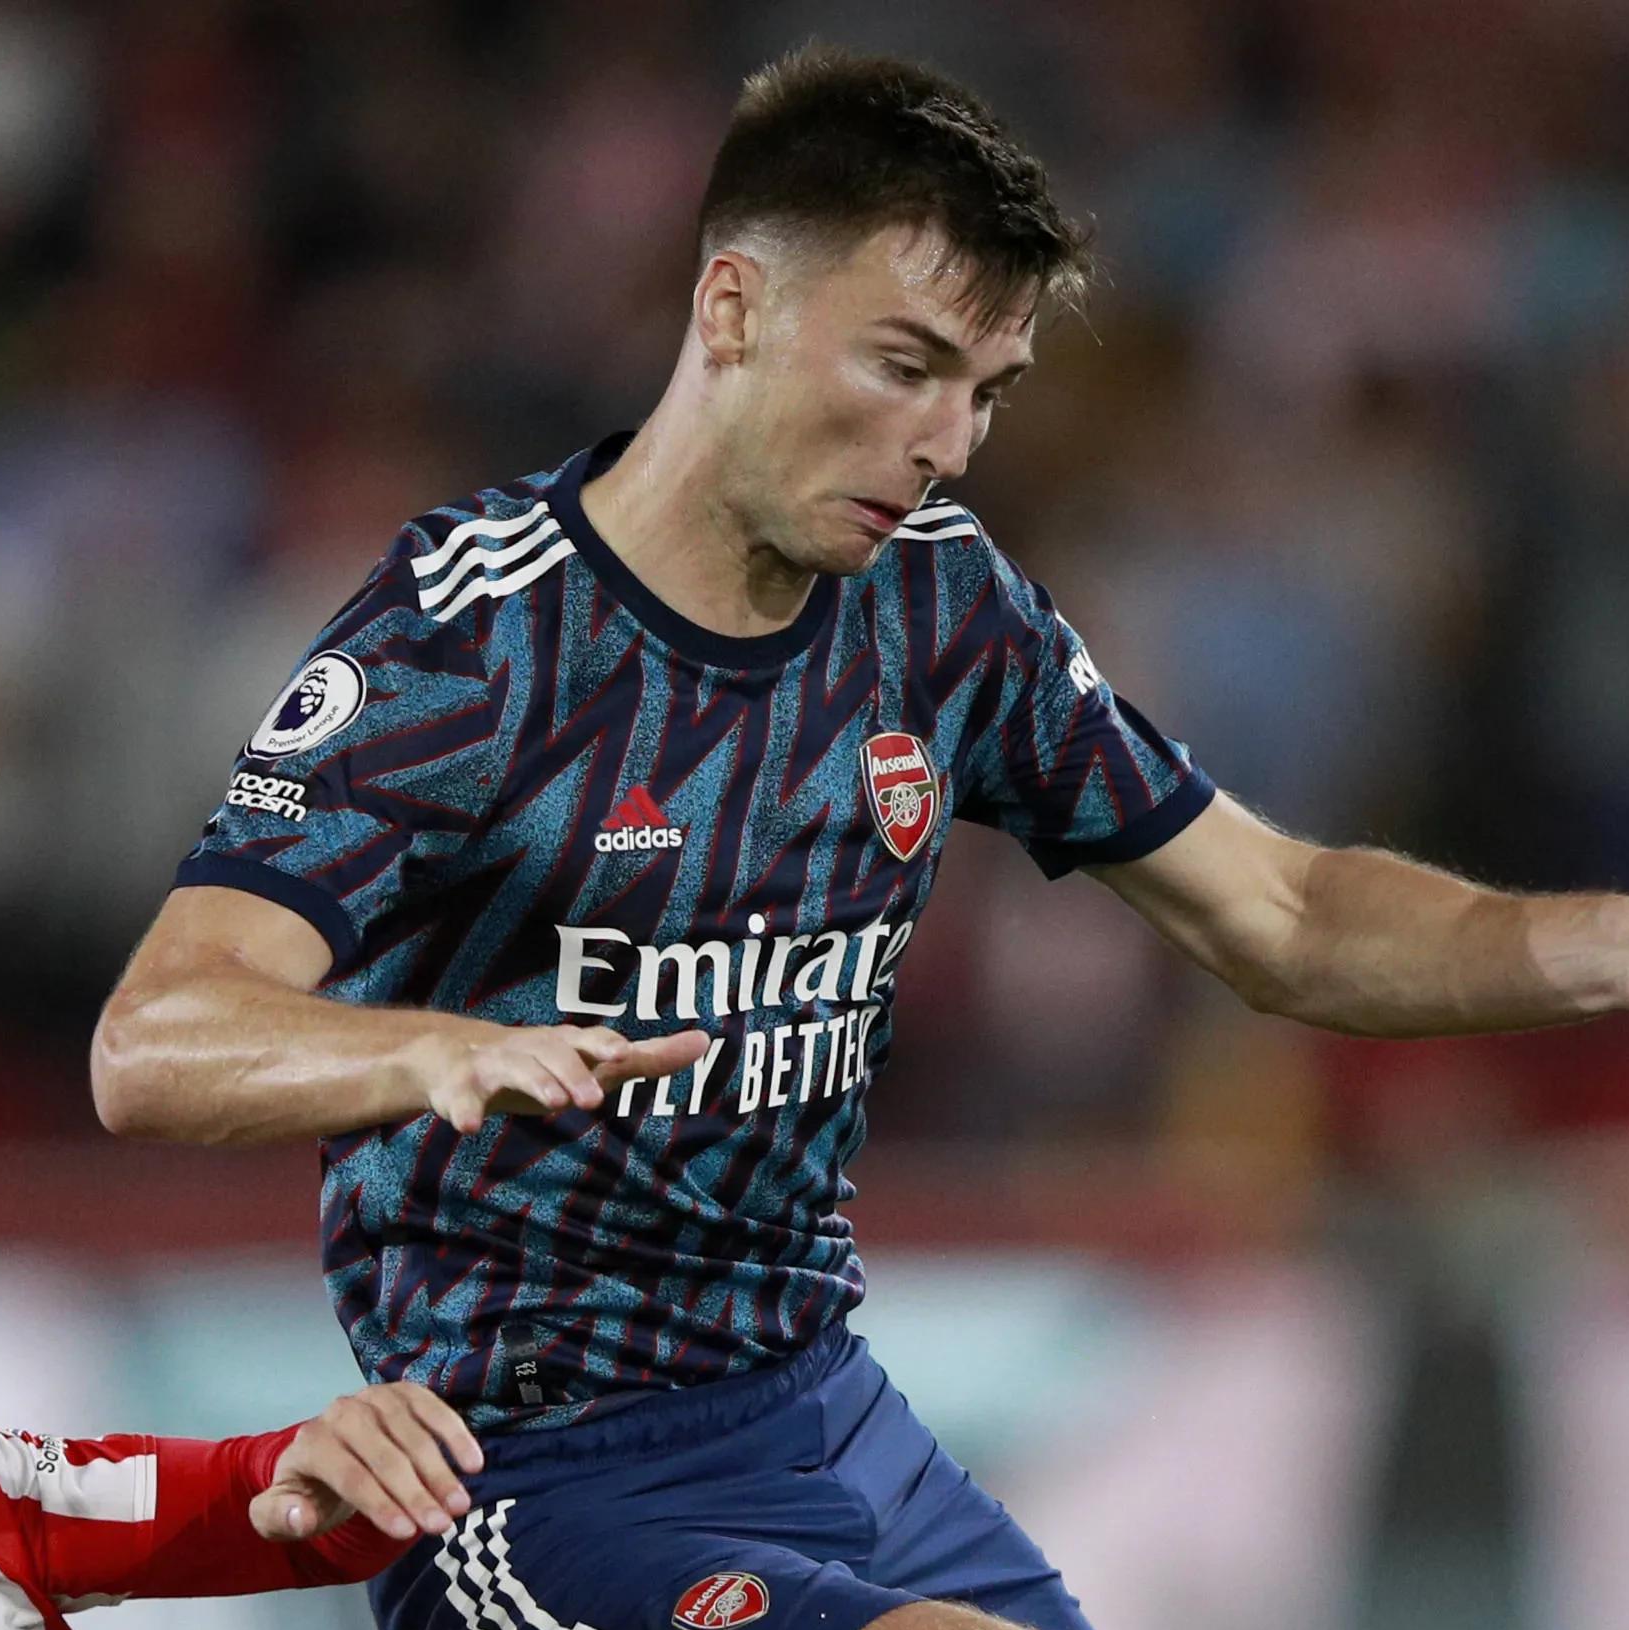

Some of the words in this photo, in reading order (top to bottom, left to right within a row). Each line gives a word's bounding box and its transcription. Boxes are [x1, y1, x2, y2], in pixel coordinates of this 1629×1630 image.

[267, 733, 306, 748] Premier
[307, 705, 339, 736] League
[232, 772, 306, 801] room
[872, 753, 924, 777] Arsenal
[594, 826, 683, 852] adidas
[554, 912, 913, 1020] Emirate
[738, 1005, 881, 1114] BETTER
[684, 1577, 730, 1621] Arsenal
